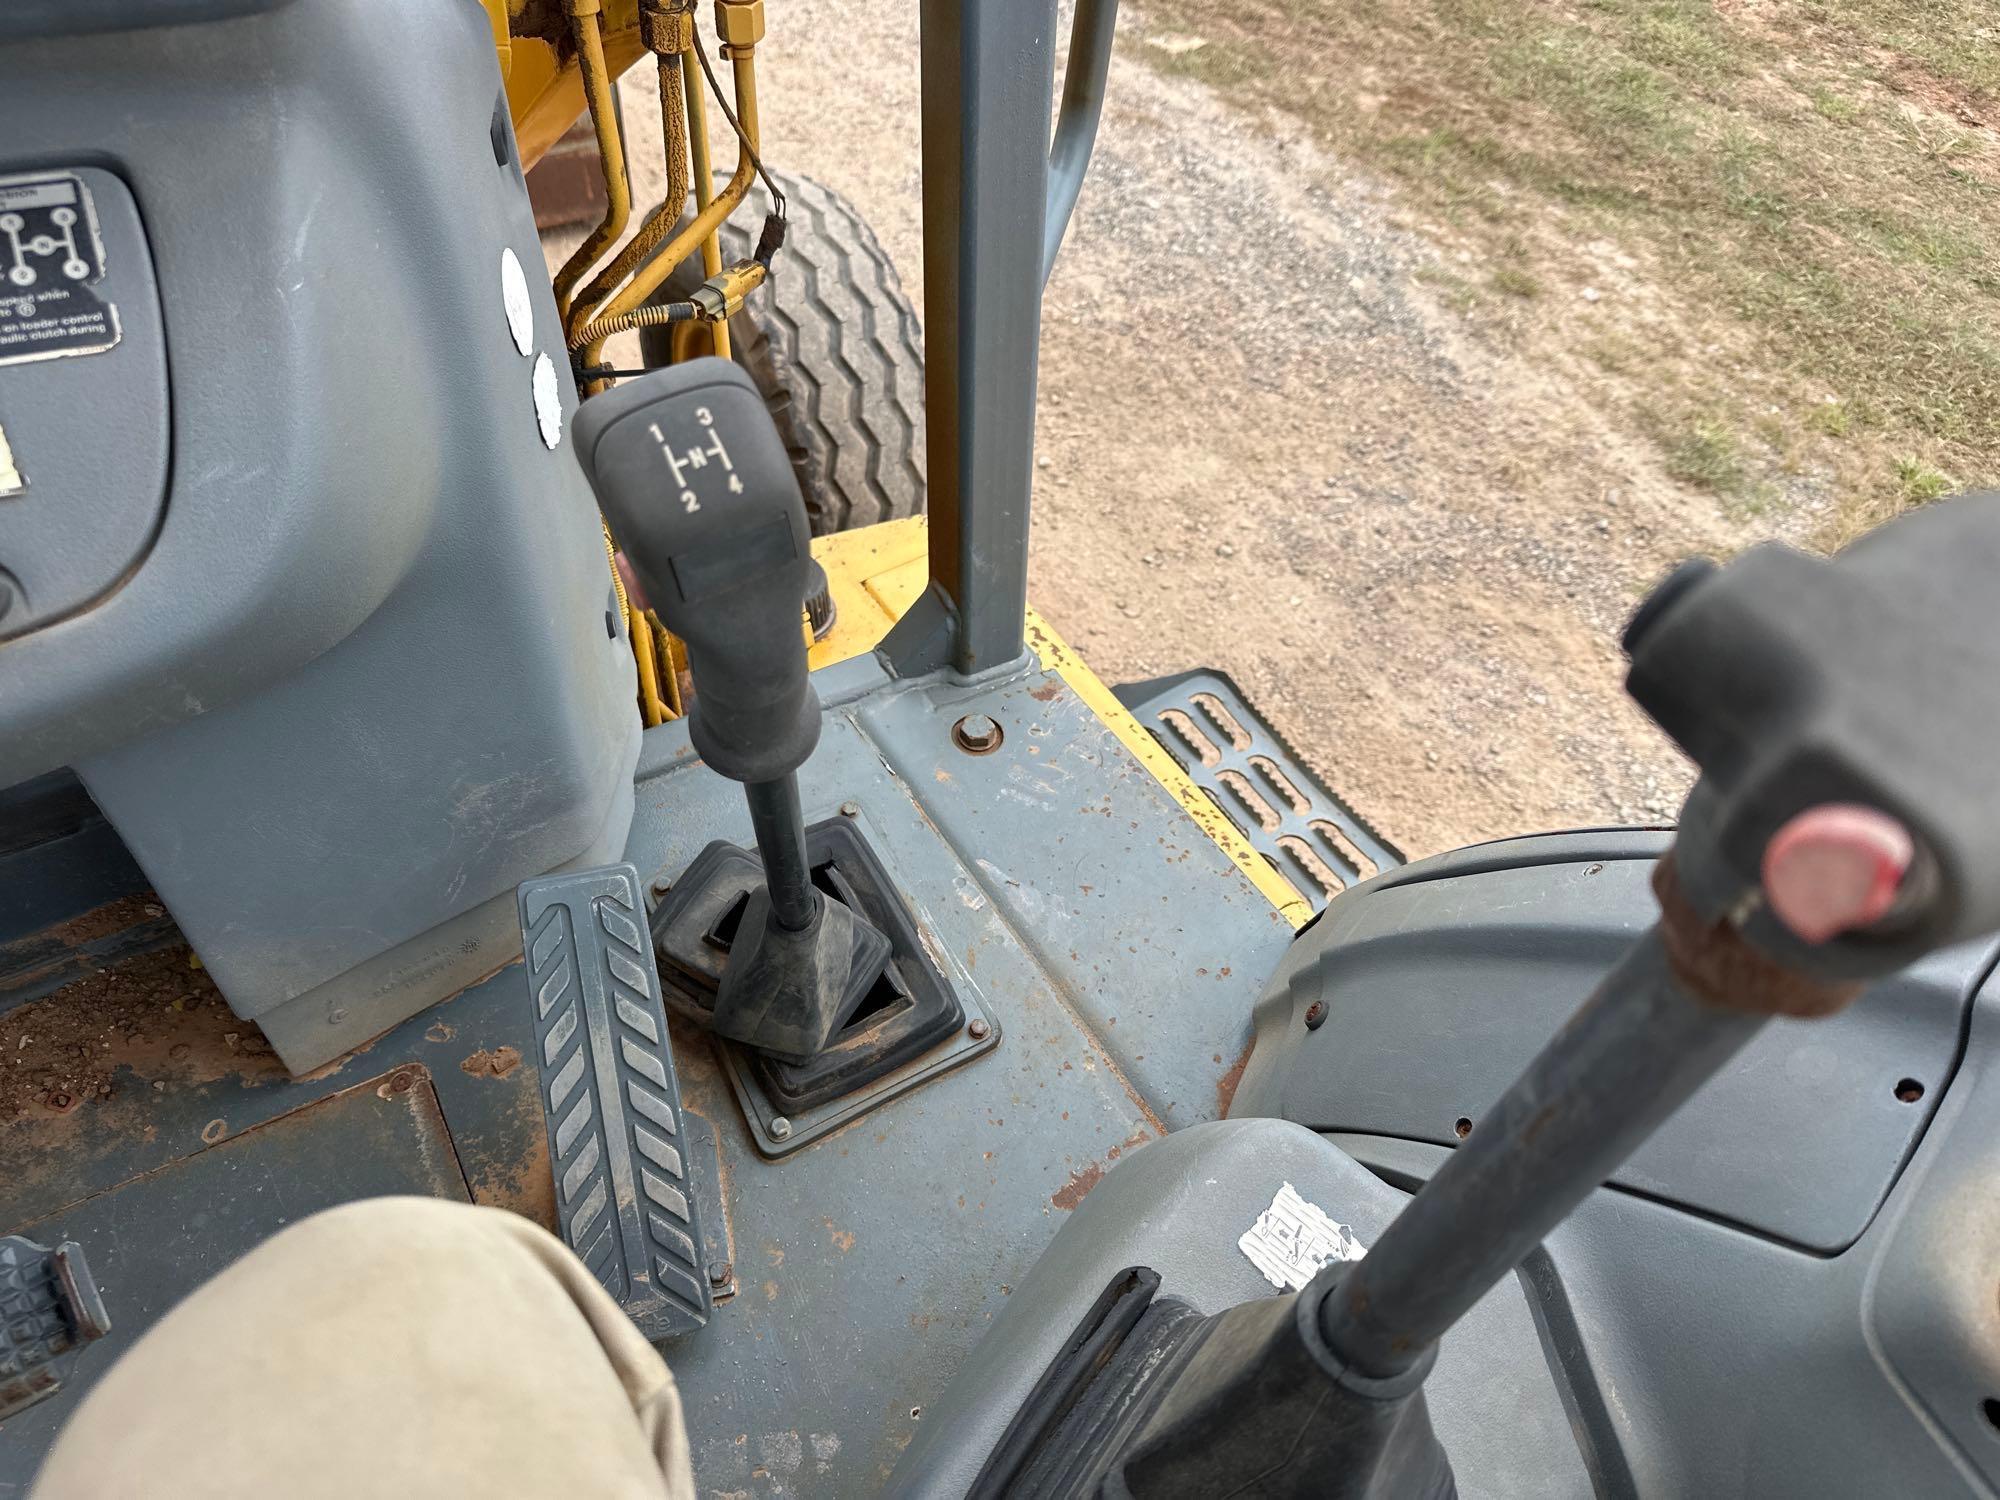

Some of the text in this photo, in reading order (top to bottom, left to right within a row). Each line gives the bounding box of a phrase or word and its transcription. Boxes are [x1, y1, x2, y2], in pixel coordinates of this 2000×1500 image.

[36, 289, 70, 301] when
[20, 319, 59, 331] loader
[60, 312, 104, 325] control
[29, 328, 67, 340] clutch
[68, 324, 107, 336] during
[695, 406, 714, 426] 3
[648, 422, 665, 443] 1
[687, 446, 708, 469] N
[728, 473, 744, 495] 4
[680, 489, 701, 513] 2
